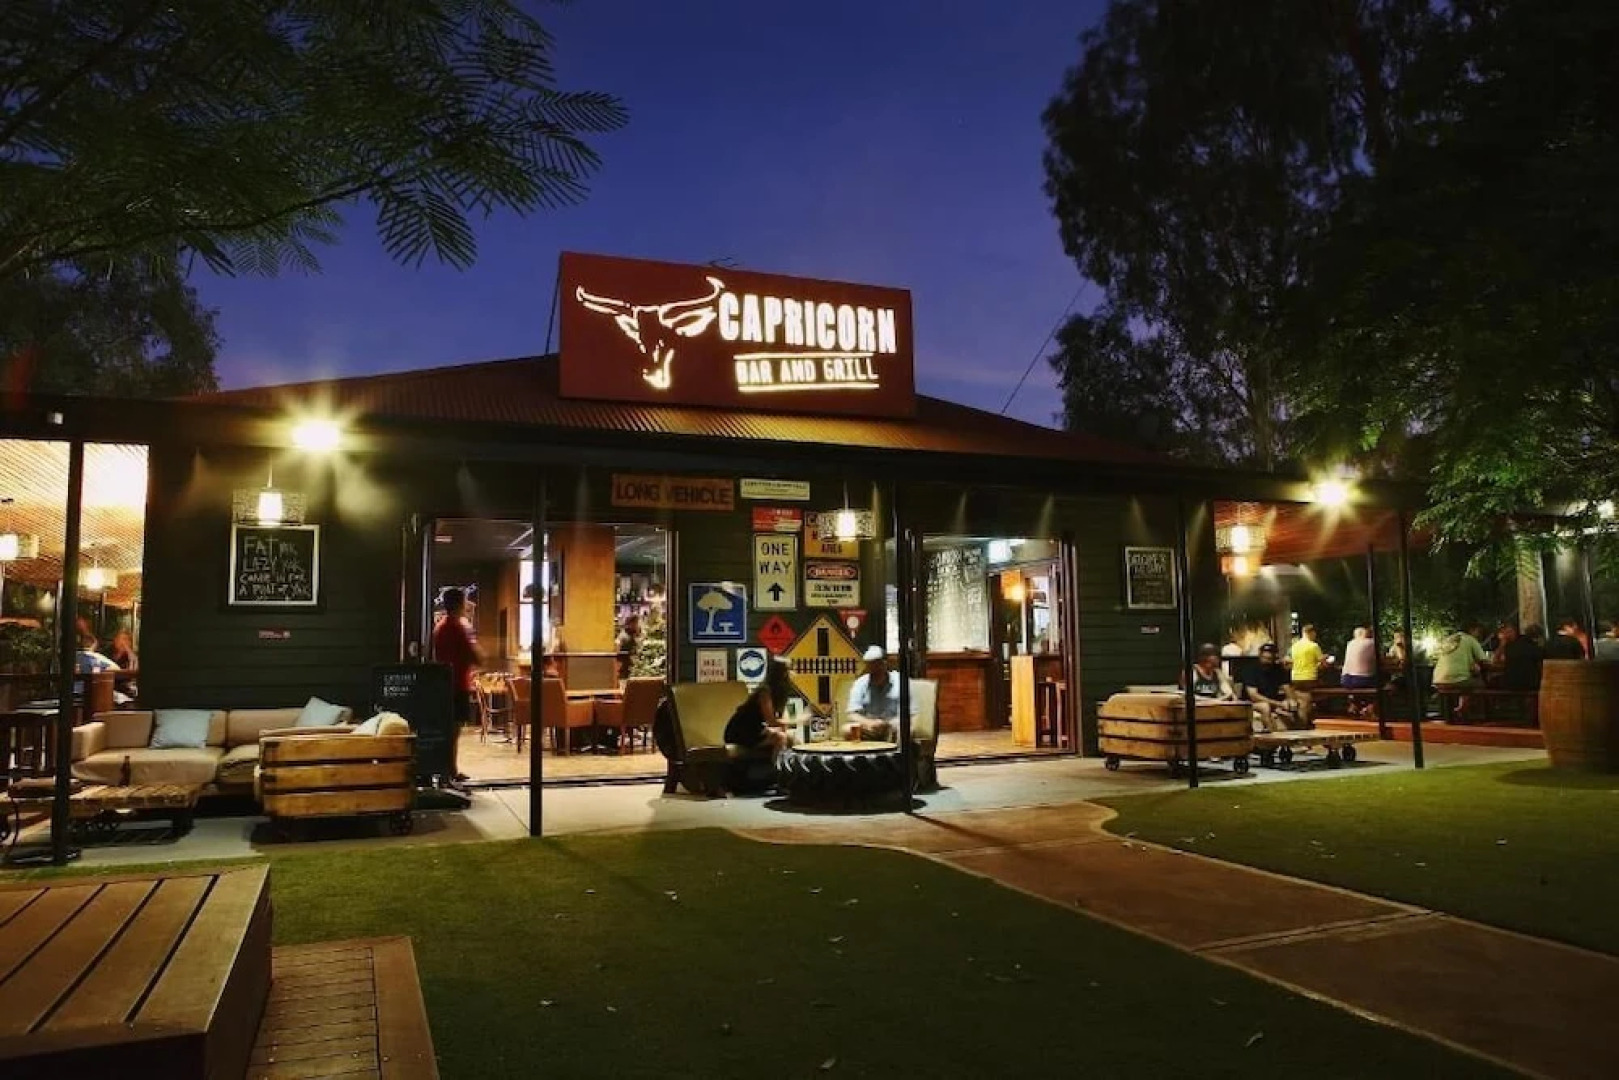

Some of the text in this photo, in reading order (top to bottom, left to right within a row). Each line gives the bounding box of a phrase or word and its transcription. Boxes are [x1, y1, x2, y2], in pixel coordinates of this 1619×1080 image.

[718, 292, 897, 354] CAPRICORN
[735, 358, 878, 384] BAR AND GRILL
[617, 483, 660, 501] LONG
[761, 542, 790, 556] ONE
[759, 561, 792, 575] WAY
